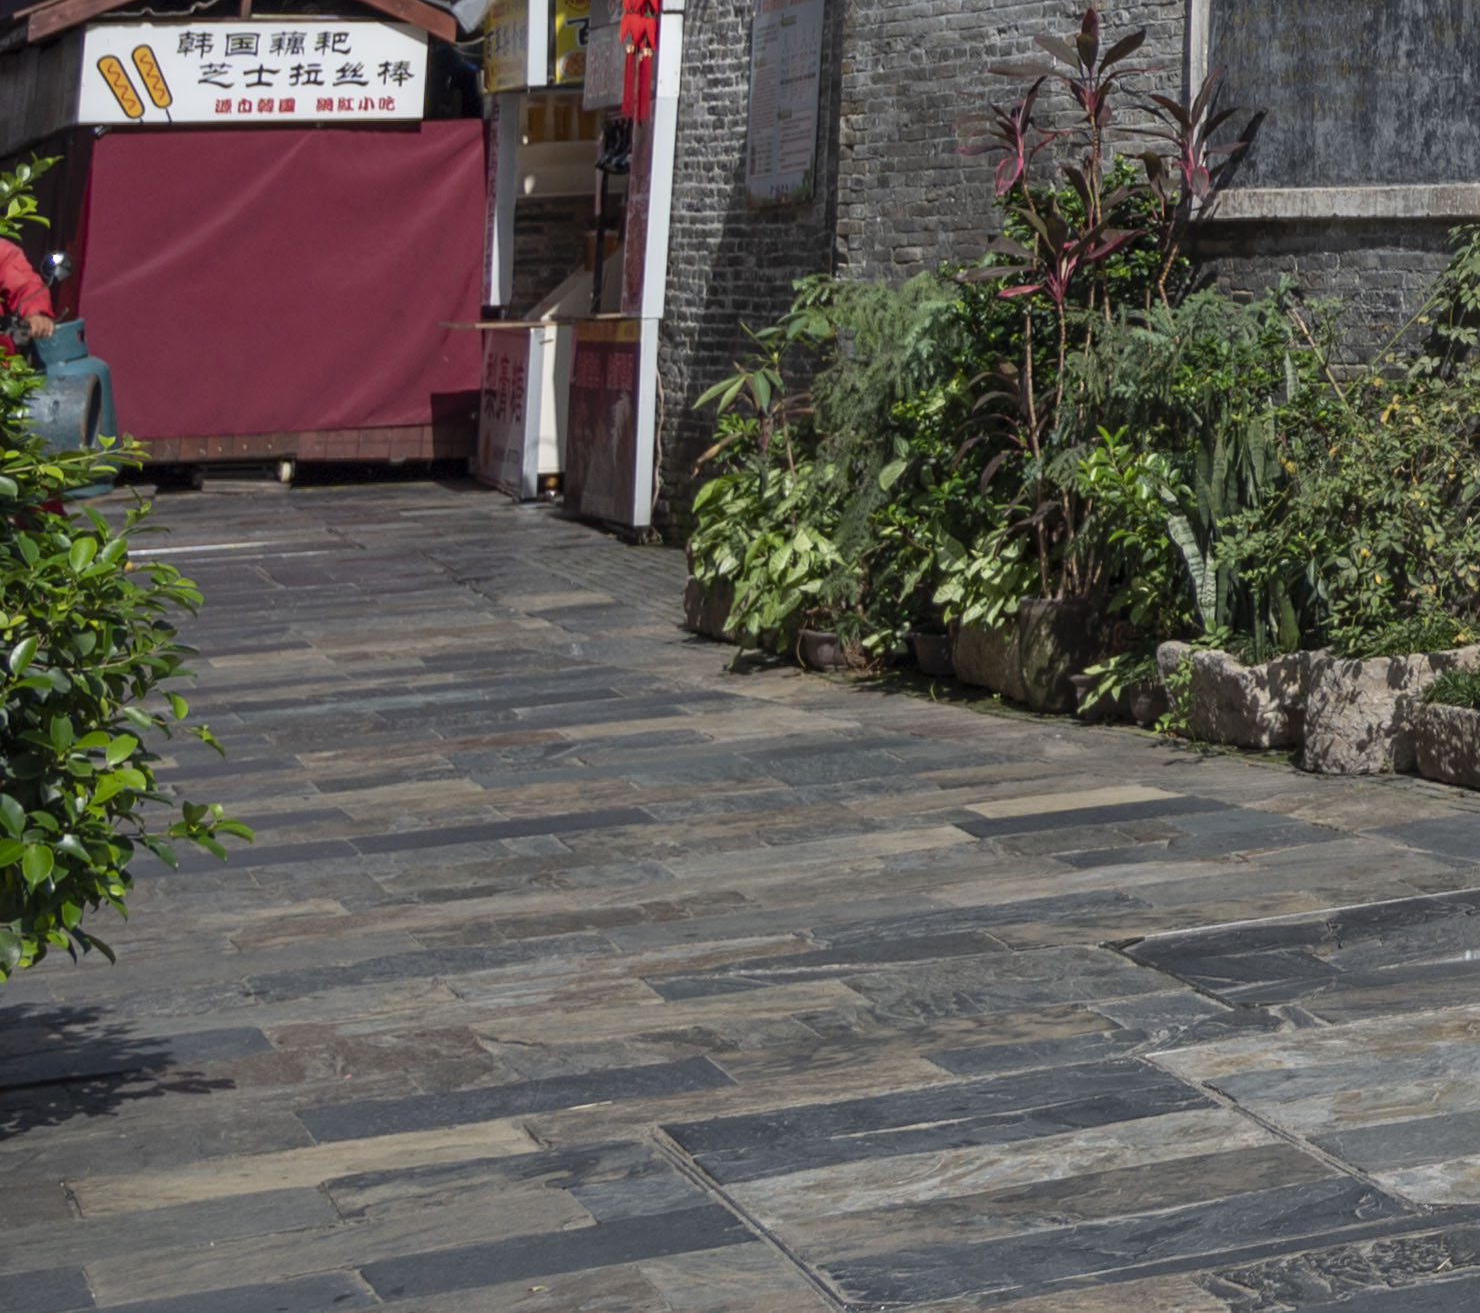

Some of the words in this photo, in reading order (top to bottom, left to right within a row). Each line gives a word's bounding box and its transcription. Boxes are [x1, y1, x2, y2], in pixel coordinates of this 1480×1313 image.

[198, 60, 415, 88] 芝士拉丝棒
